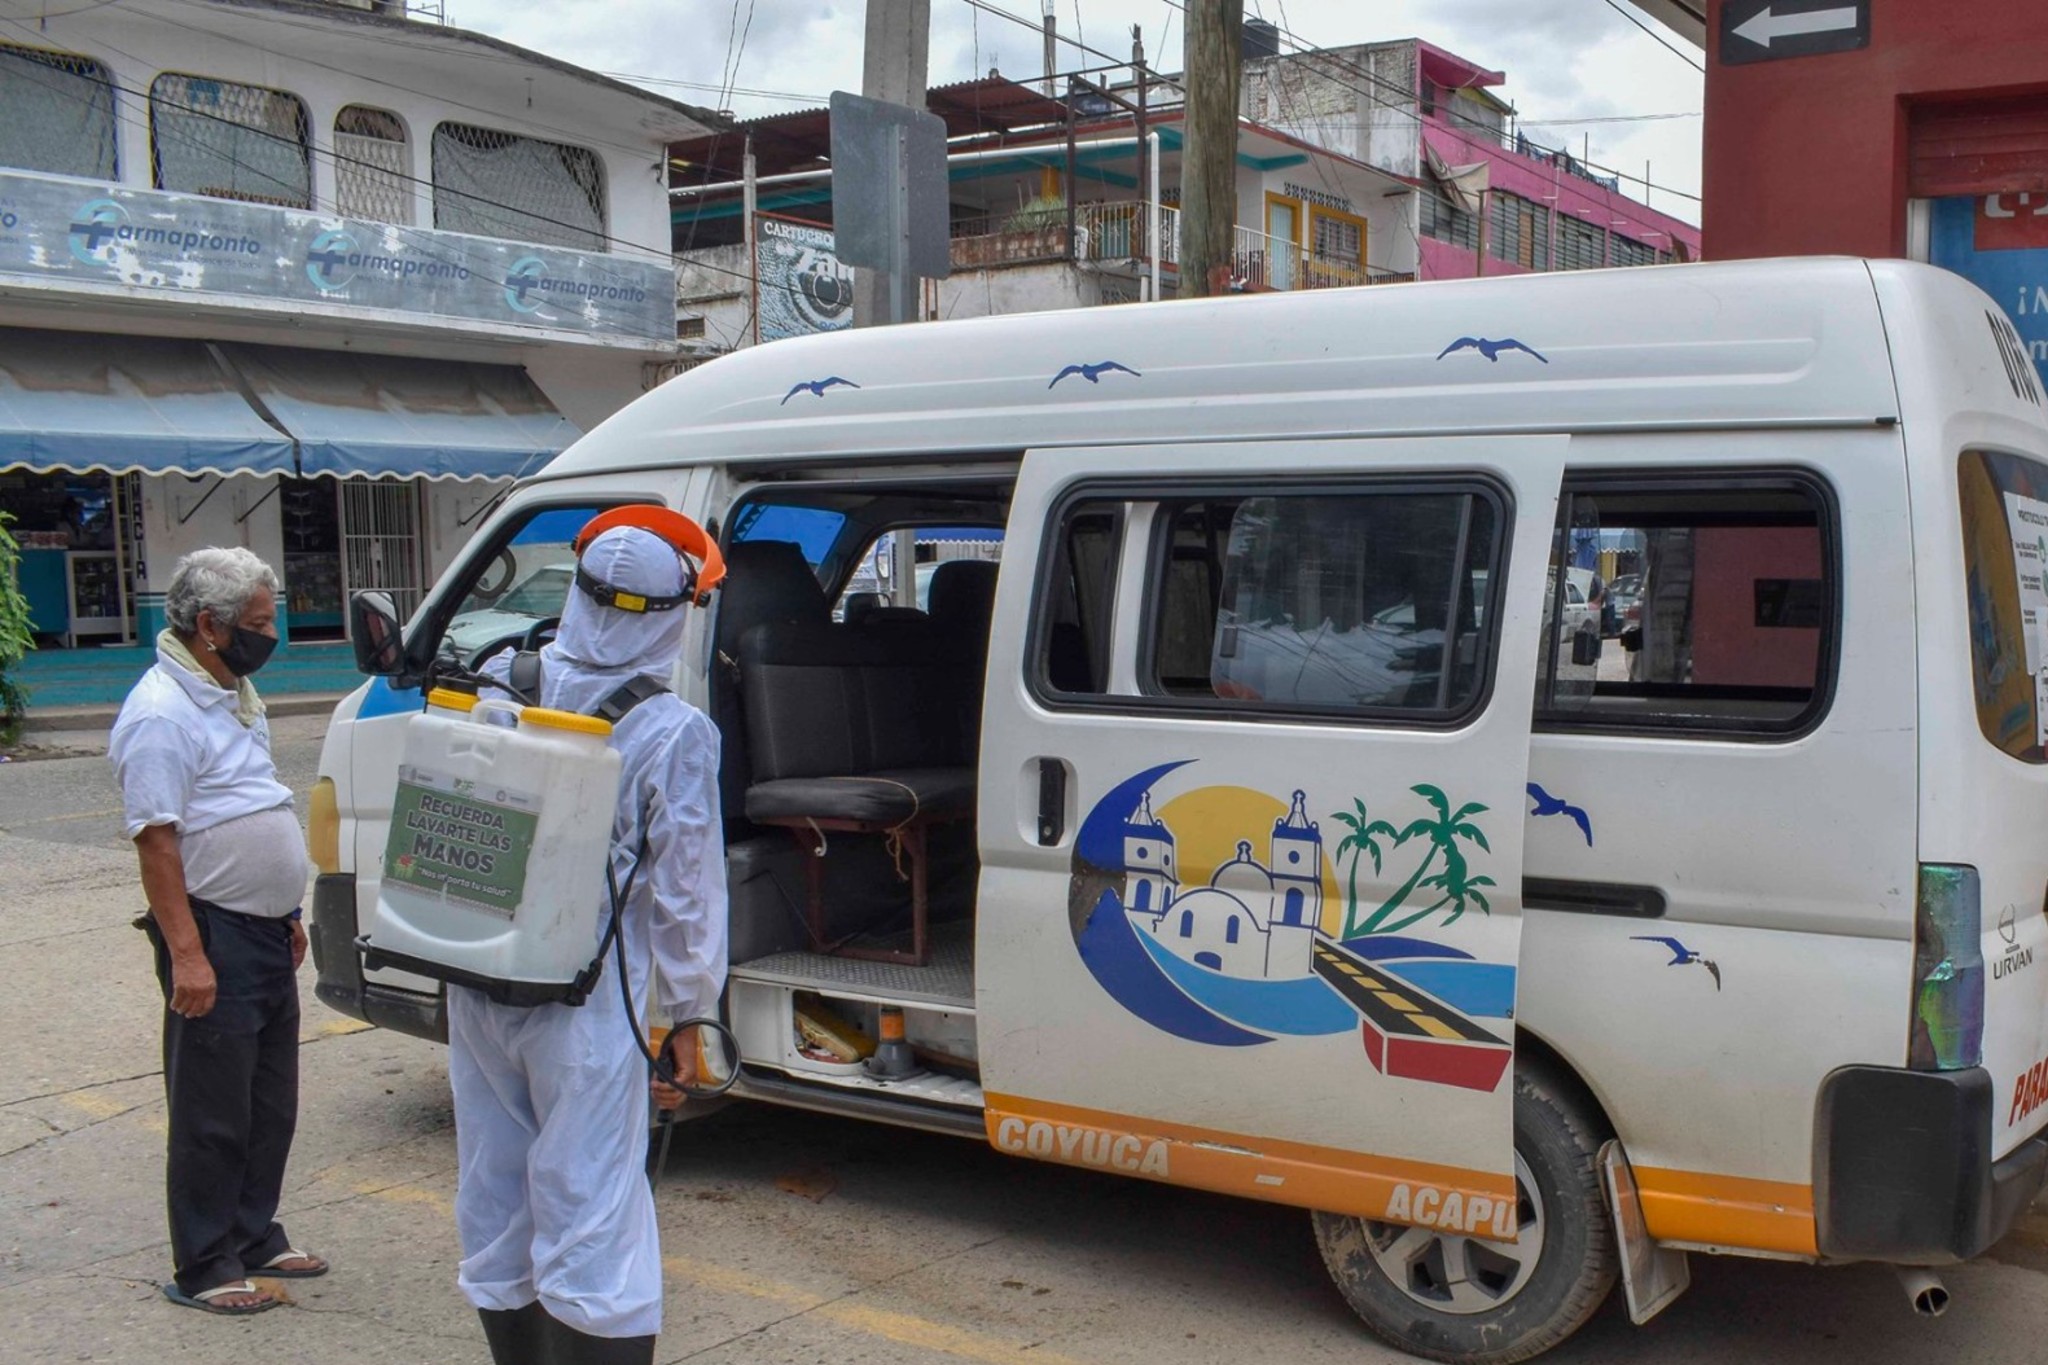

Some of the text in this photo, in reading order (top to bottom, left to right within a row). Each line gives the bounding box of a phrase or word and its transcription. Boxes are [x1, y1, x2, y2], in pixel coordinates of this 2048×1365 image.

[406, 810, 512, 853] LAVARTE LAS
[420, 794, 504, 830] RECUERDA
[412, 833, 495, 876] MANOS
[1993, 947, 2033, 980] URVAN
[998, 1117, 1169, 1177] COYUCA
[1386, 1183, 1517, 1239] ACAPU
